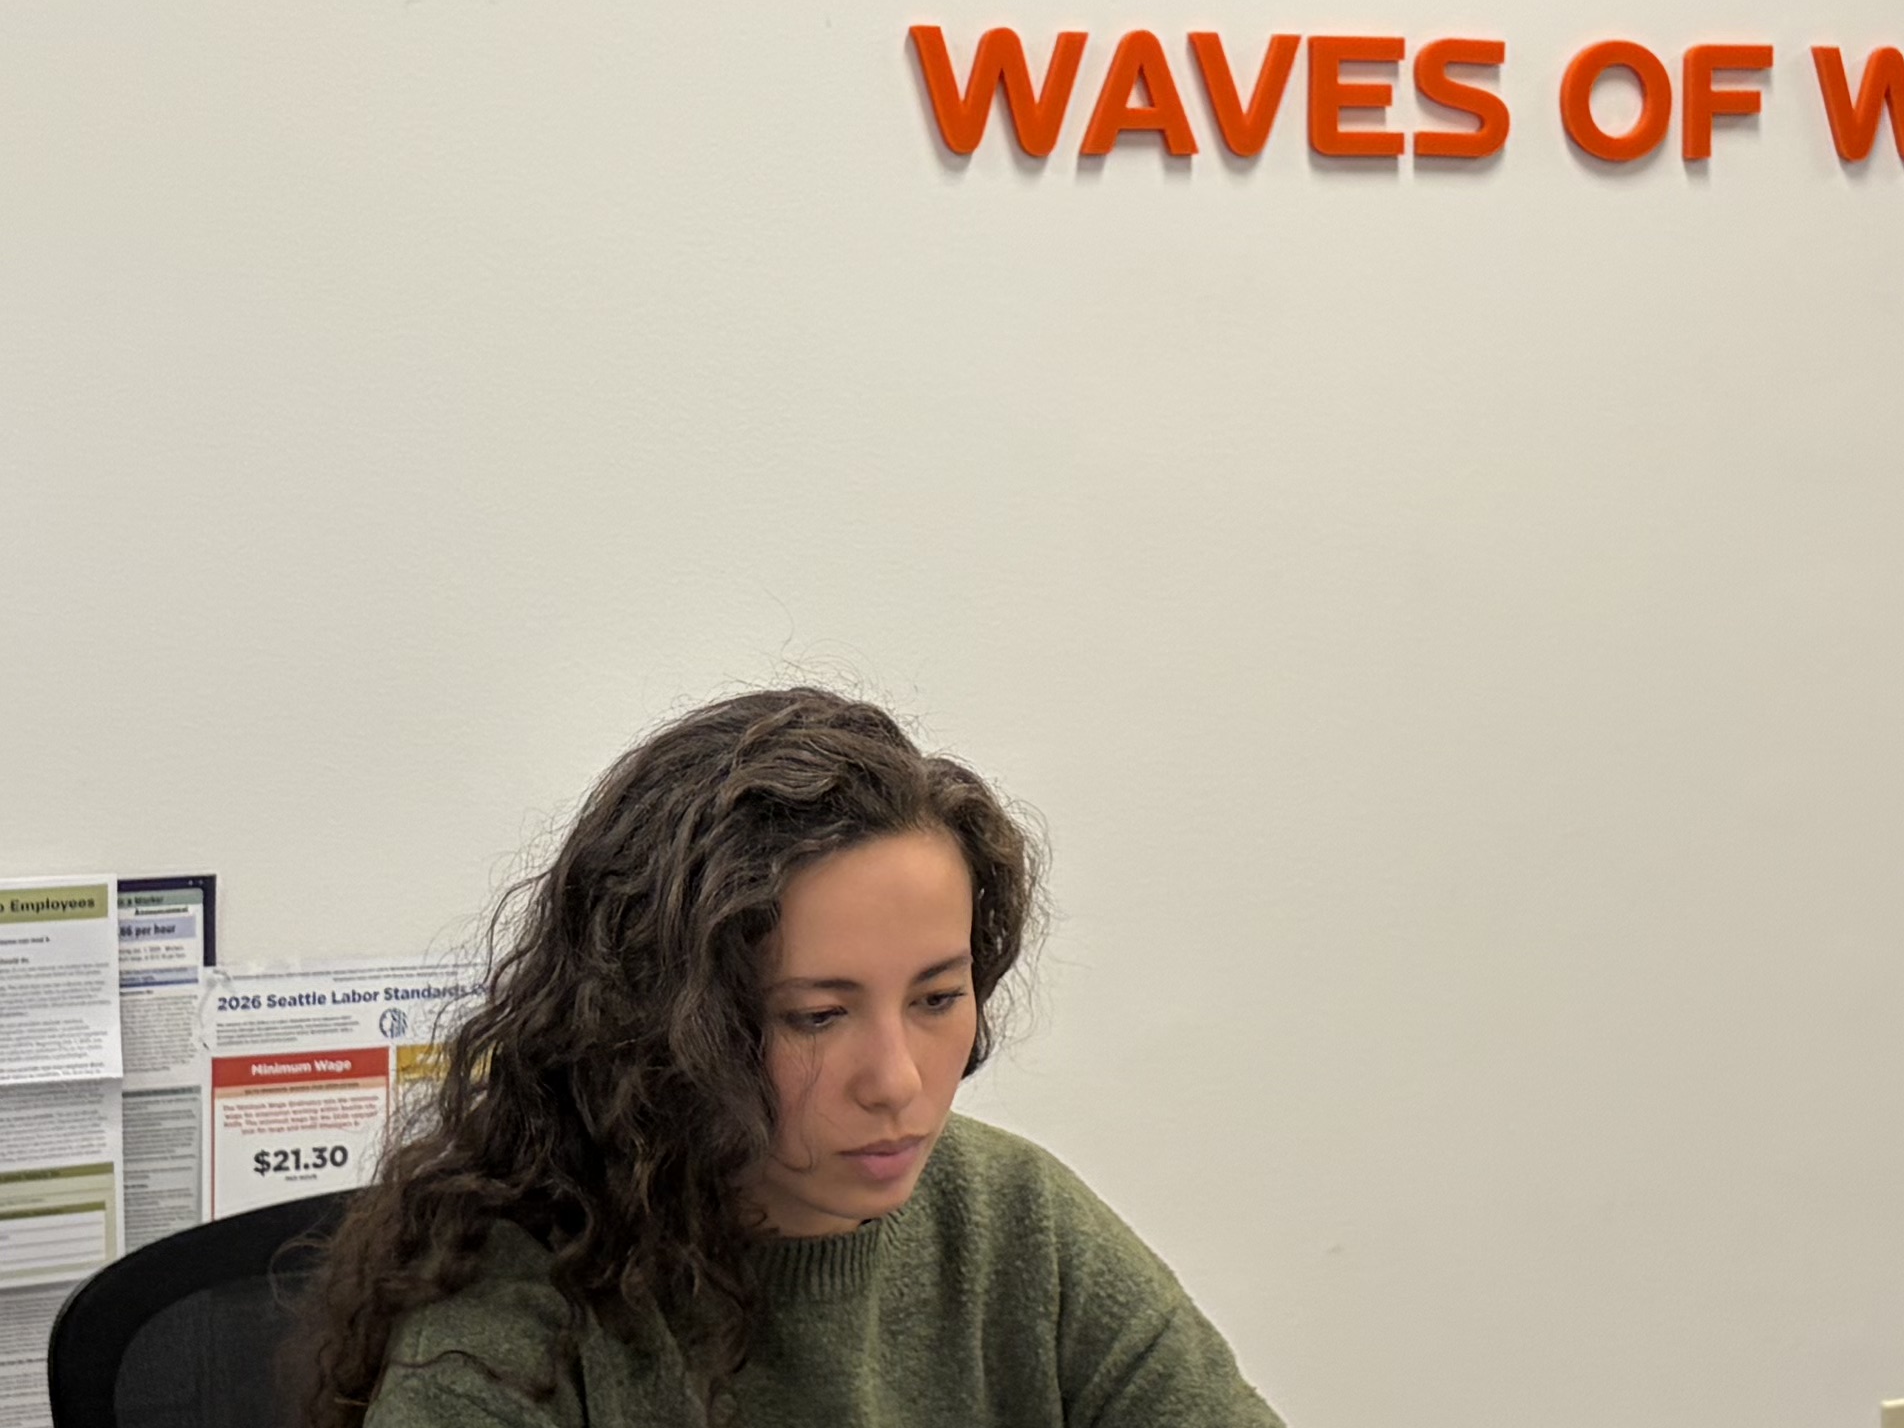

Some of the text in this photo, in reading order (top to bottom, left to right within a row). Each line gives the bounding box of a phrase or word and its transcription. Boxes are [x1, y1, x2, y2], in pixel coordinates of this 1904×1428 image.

[909, 26, 1509, 161] WAVES
[1560, 41, 1773, 161] OF
[10, 895, 96, 916] Employees
[135, 923, 176, 939] per hour
[217, 983, 465, 1011] 2026 Seattle Labor Standards
[251, 1057, 352, 1076] Minimum Wage
[253, 1145, 349, 1177] $21.30
